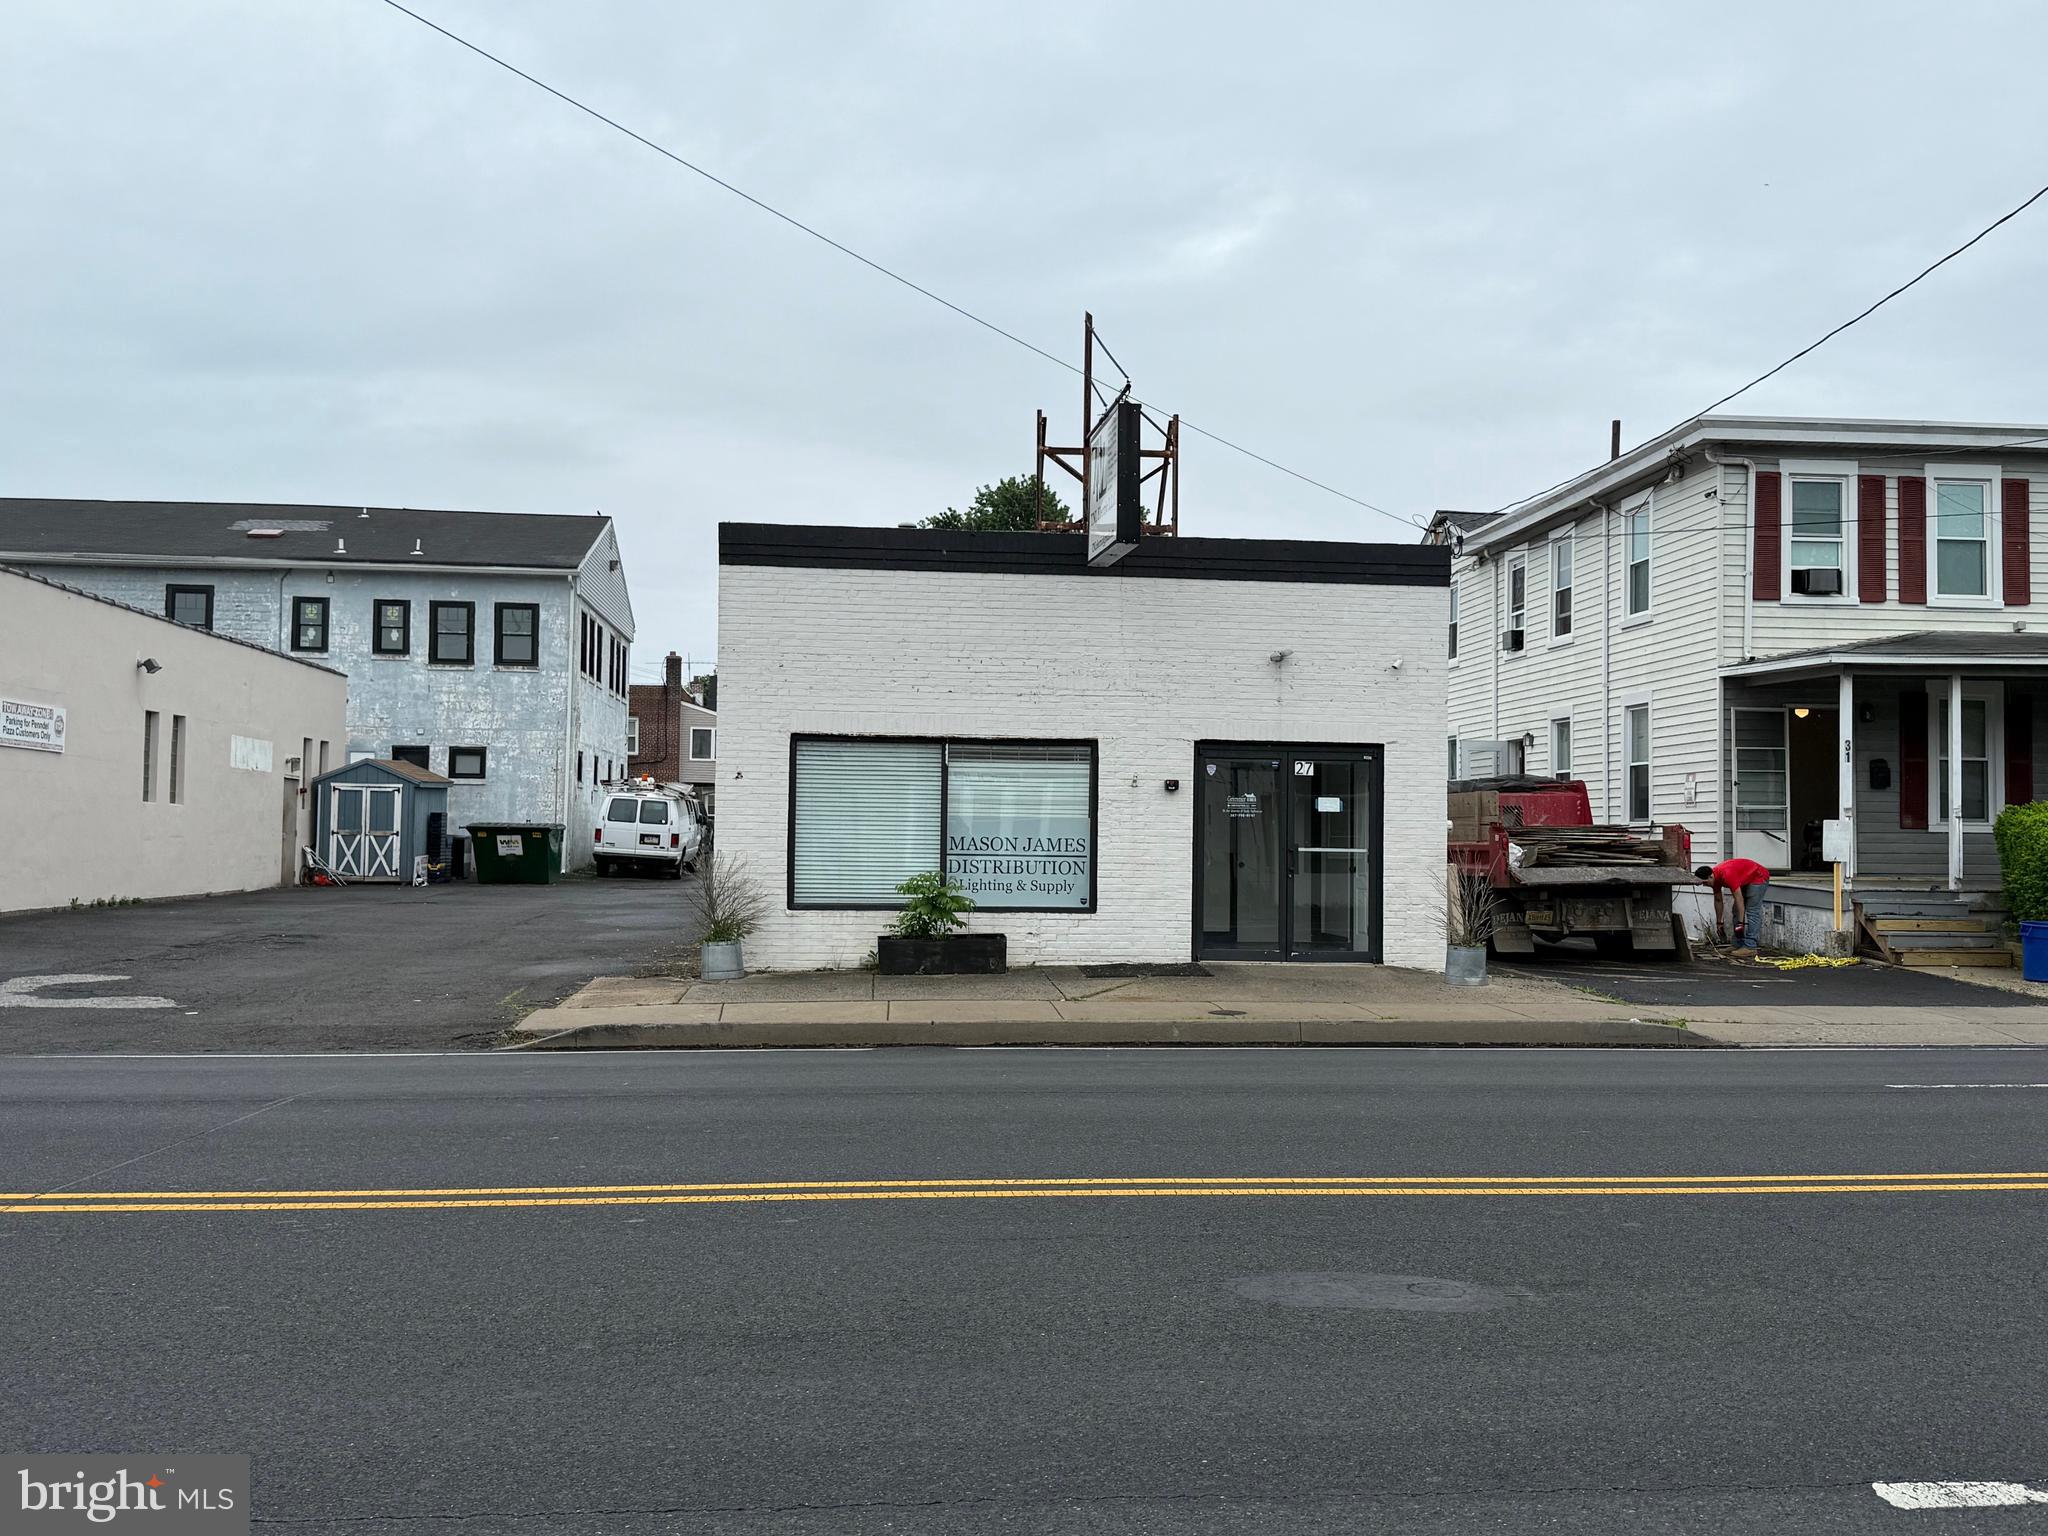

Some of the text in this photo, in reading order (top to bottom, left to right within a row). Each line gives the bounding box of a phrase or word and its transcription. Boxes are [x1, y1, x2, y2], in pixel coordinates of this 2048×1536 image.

[6, 715, 23, 728] Parking
[3, 725, 51, 742] Pizza Customers Only
[1845, 740, 1851, 763] 31
[1296, 761, 1313, 775] 27
[950, 836, 1086, 853] MASON JAMES
[949, 859, 1086, 875] DISTRIBUTION
[959, 878, 1075, 894] Lighting & Supply
